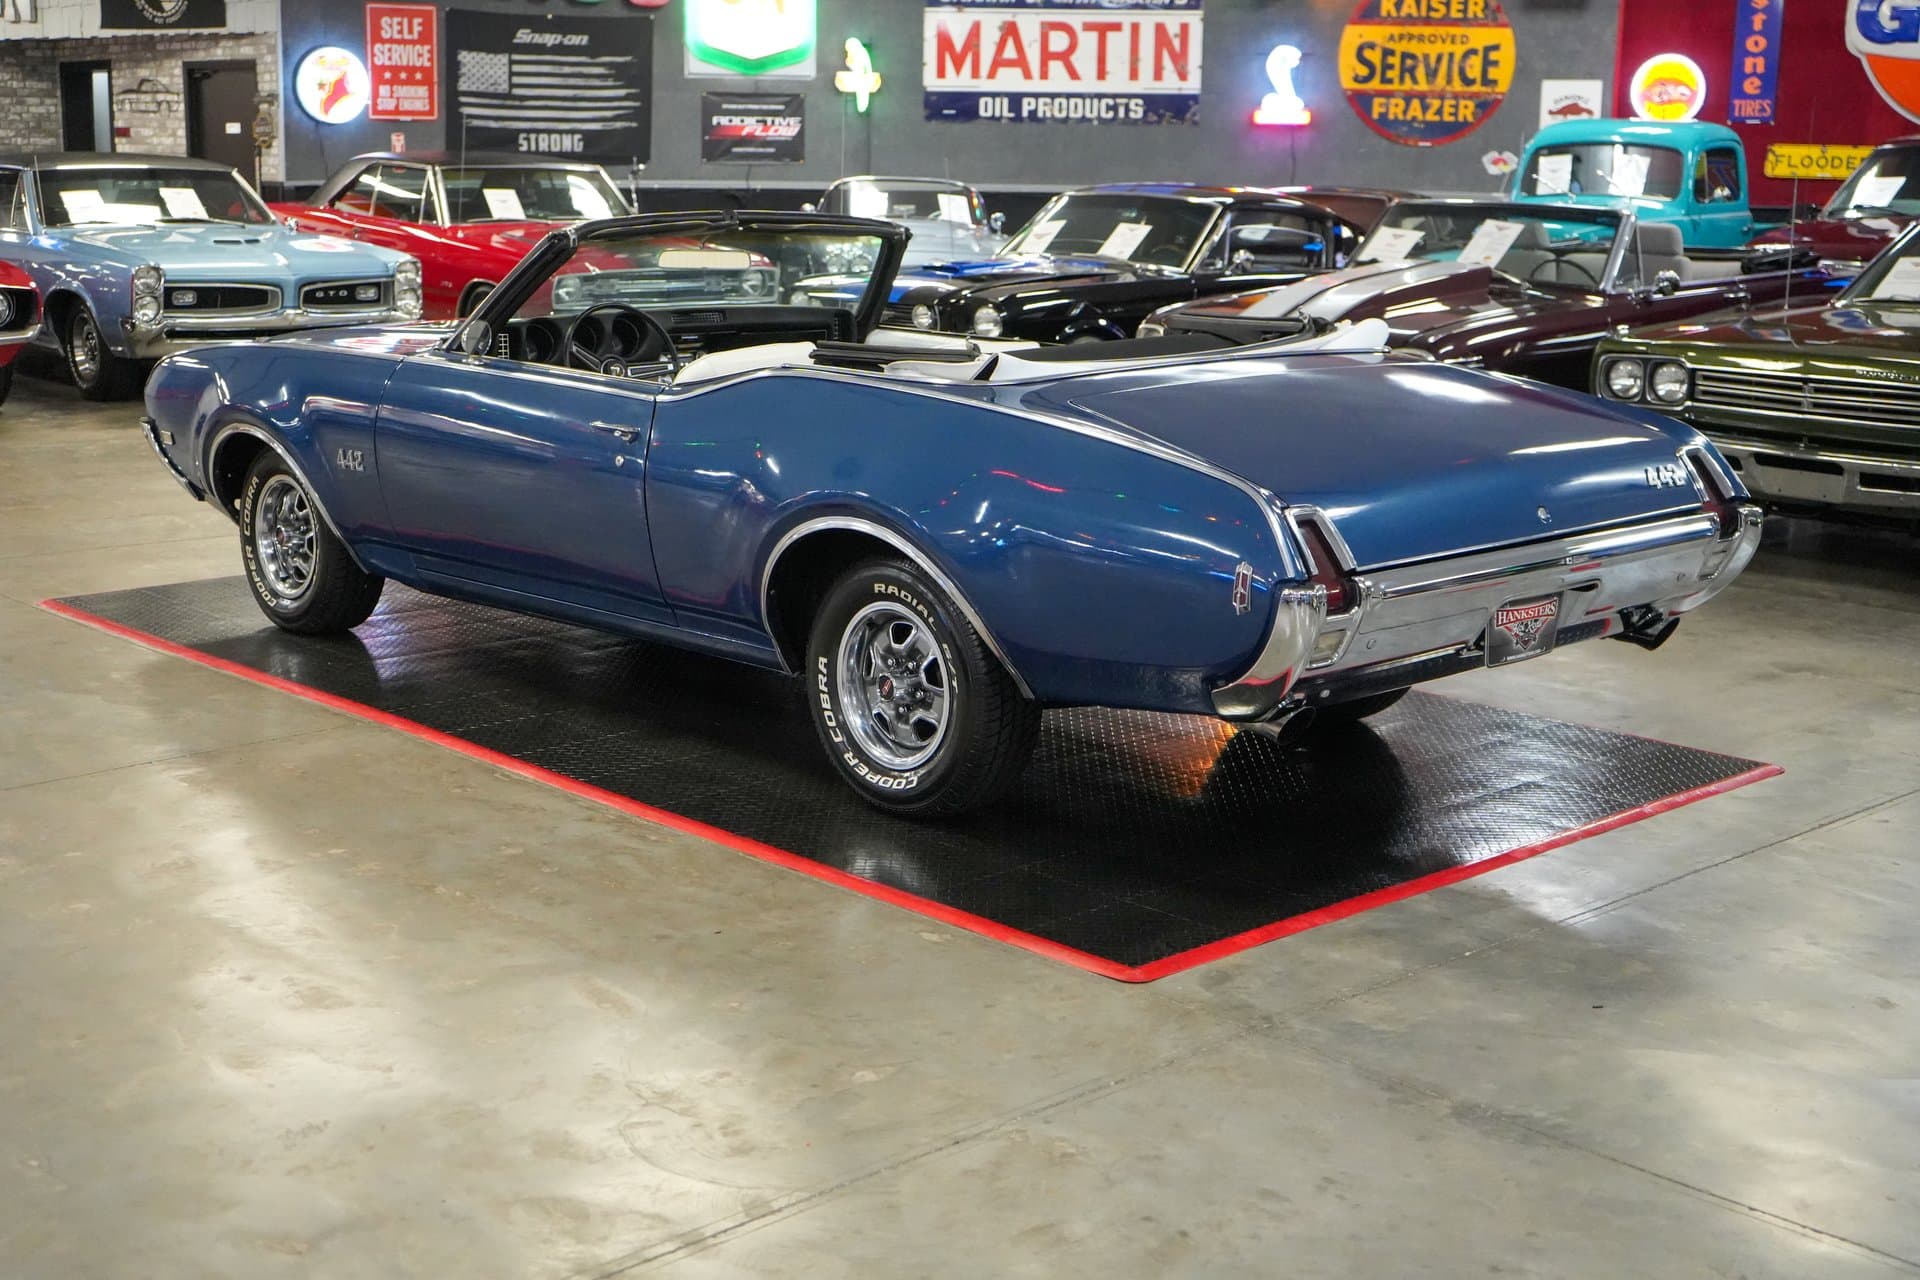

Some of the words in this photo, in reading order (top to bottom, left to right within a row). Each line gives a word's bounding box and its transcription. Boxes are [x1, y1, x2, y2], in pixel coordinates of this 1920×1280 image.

[1380, 0, 1487, 19] KAISER
[380, 16, 423, 40] SELF
[512, 28, 589, 47] Snap-on
[1387, 32, 1471, 45] APPROVED
[373, 43, 432, 67] SERVICE
[936, 20, 1190, 82] MARTIN
[1352, 40, 1503, 87] SERVICE
[712, 115, 802, 126] ADDICTIVE
[979, 97, 1016, 118] OIL
[1021, 97, 1145, 120] PRODUCTS
[1371, 96, 1477, 123] FRAZER
[1733, 99, 1772, 118] TIRES
[518, 133, 584, 152] STRONG
[741, 126, 801, 137] FLOW
[1774, 154, 1867, 172] FLOODE
[315, 284, 348, 299] GTO
[337, 448, 365, 472] 442
[1645, 463, 1686, 490] 442
[244, 475, 260, 537] COBRA
[245, 545, 278, 607] COOPER
[874, 583, 938, 632] RADIAL
[1498, 601, 1557, 625] HANKSTERS
[818, 656, 841, 744] COBRA
[843, 751, 919, 789] COOPER
